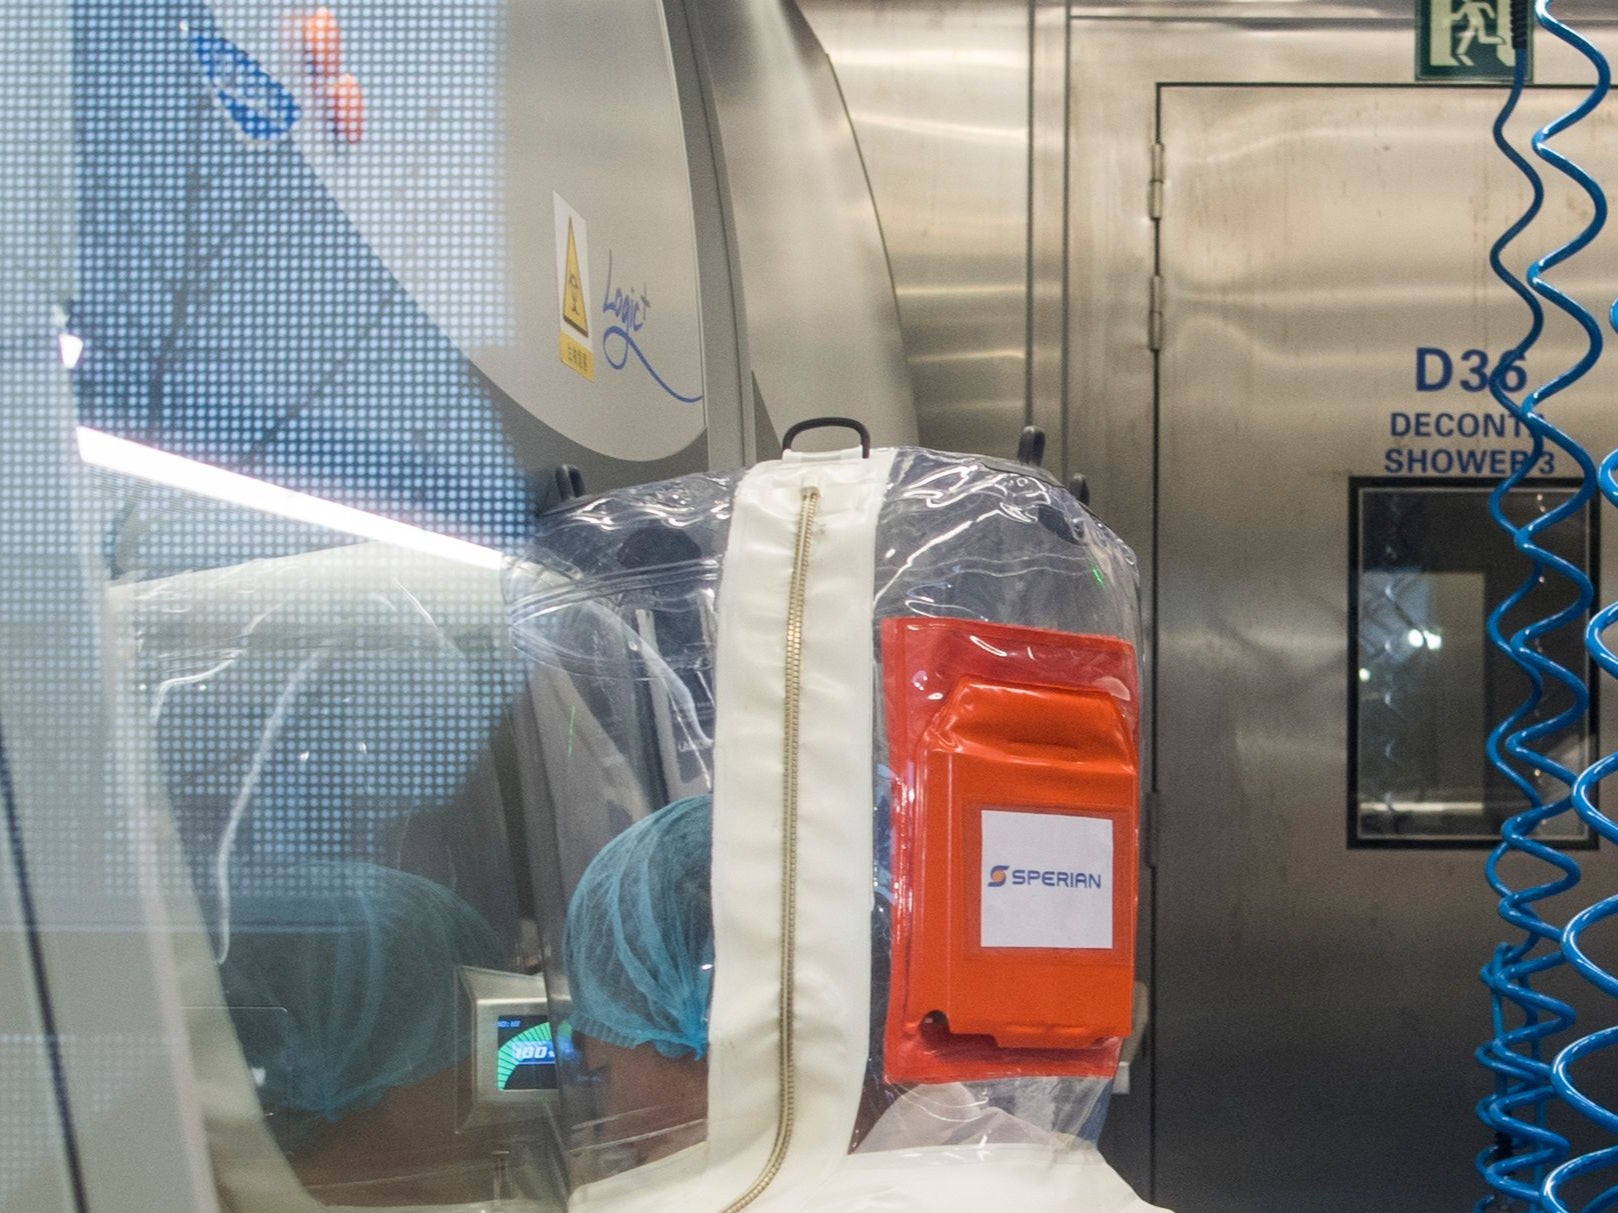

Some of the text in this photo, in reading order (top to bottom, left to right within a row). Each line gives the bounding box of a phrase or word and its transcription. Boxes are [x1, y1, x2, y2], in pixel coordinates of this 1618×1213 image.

[1416, 347, 1528, 392] D36
[1539, 450, 1555, 475] 3
[1011, 869, 1101, 889] SPERIAN
